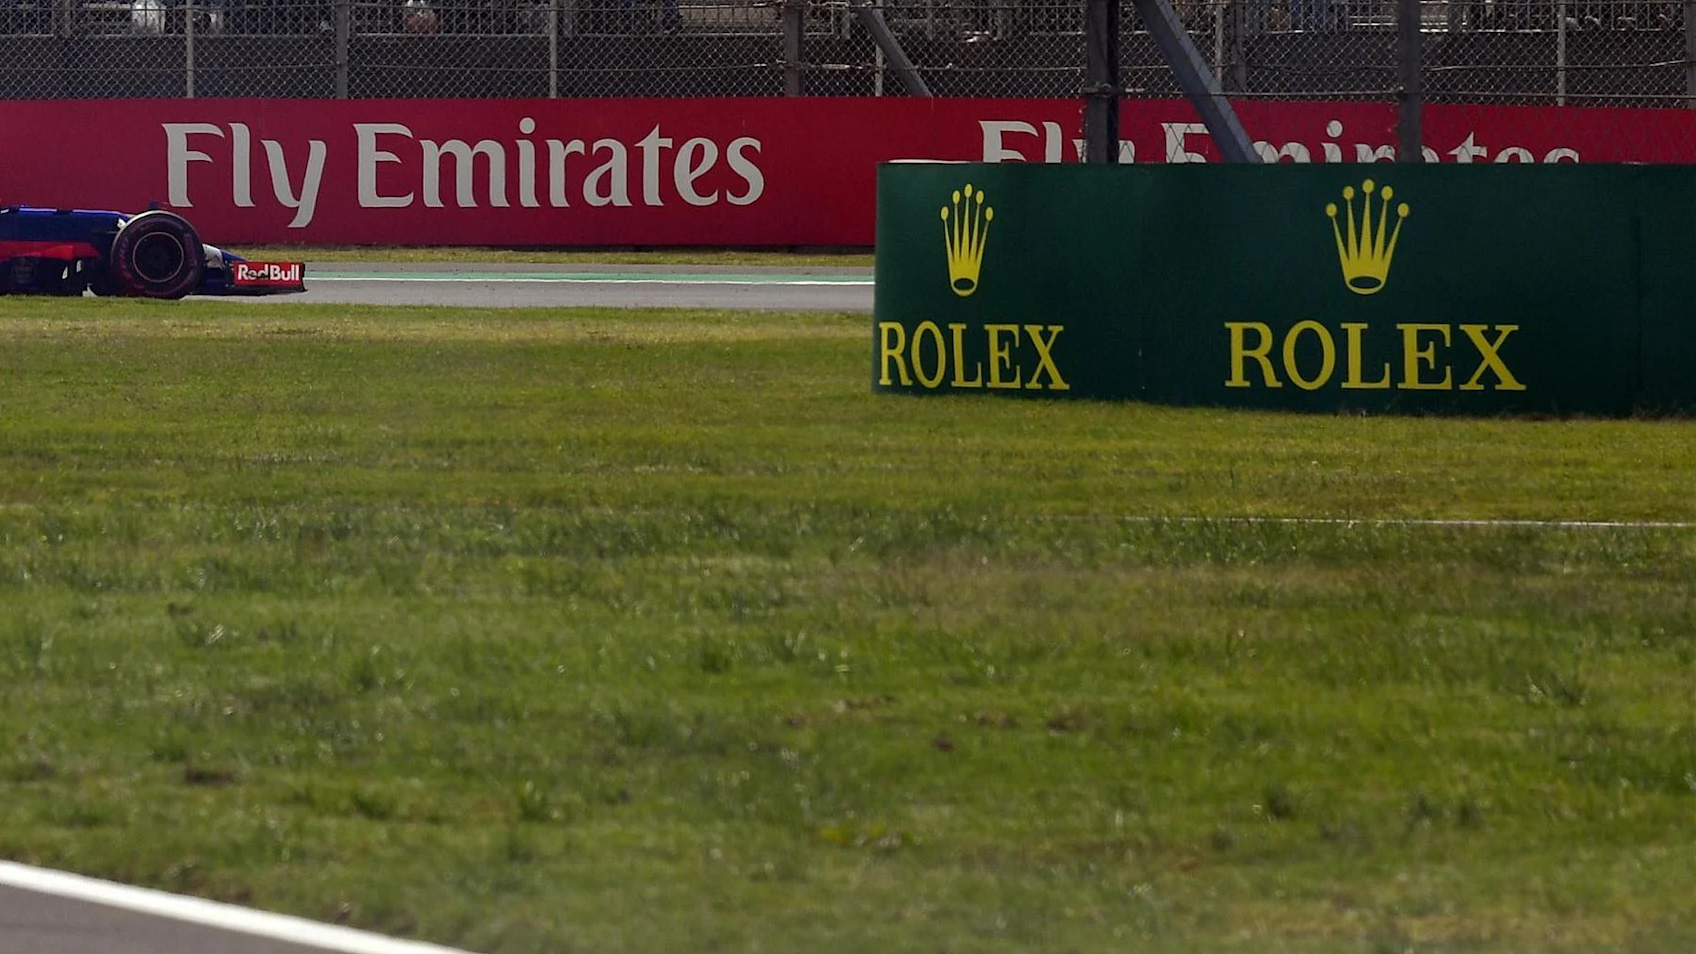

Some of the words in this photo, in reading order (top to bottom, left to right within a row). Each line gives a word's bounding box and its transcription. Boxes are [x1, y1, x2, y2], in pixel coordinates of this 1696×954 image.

[162, 122, 327, 229] Fly
[353, 116, 765, 208] Emirates
[878, 321, 1071, 391] ROLEX
[1224, 319, 1527, 392] ROLEX
